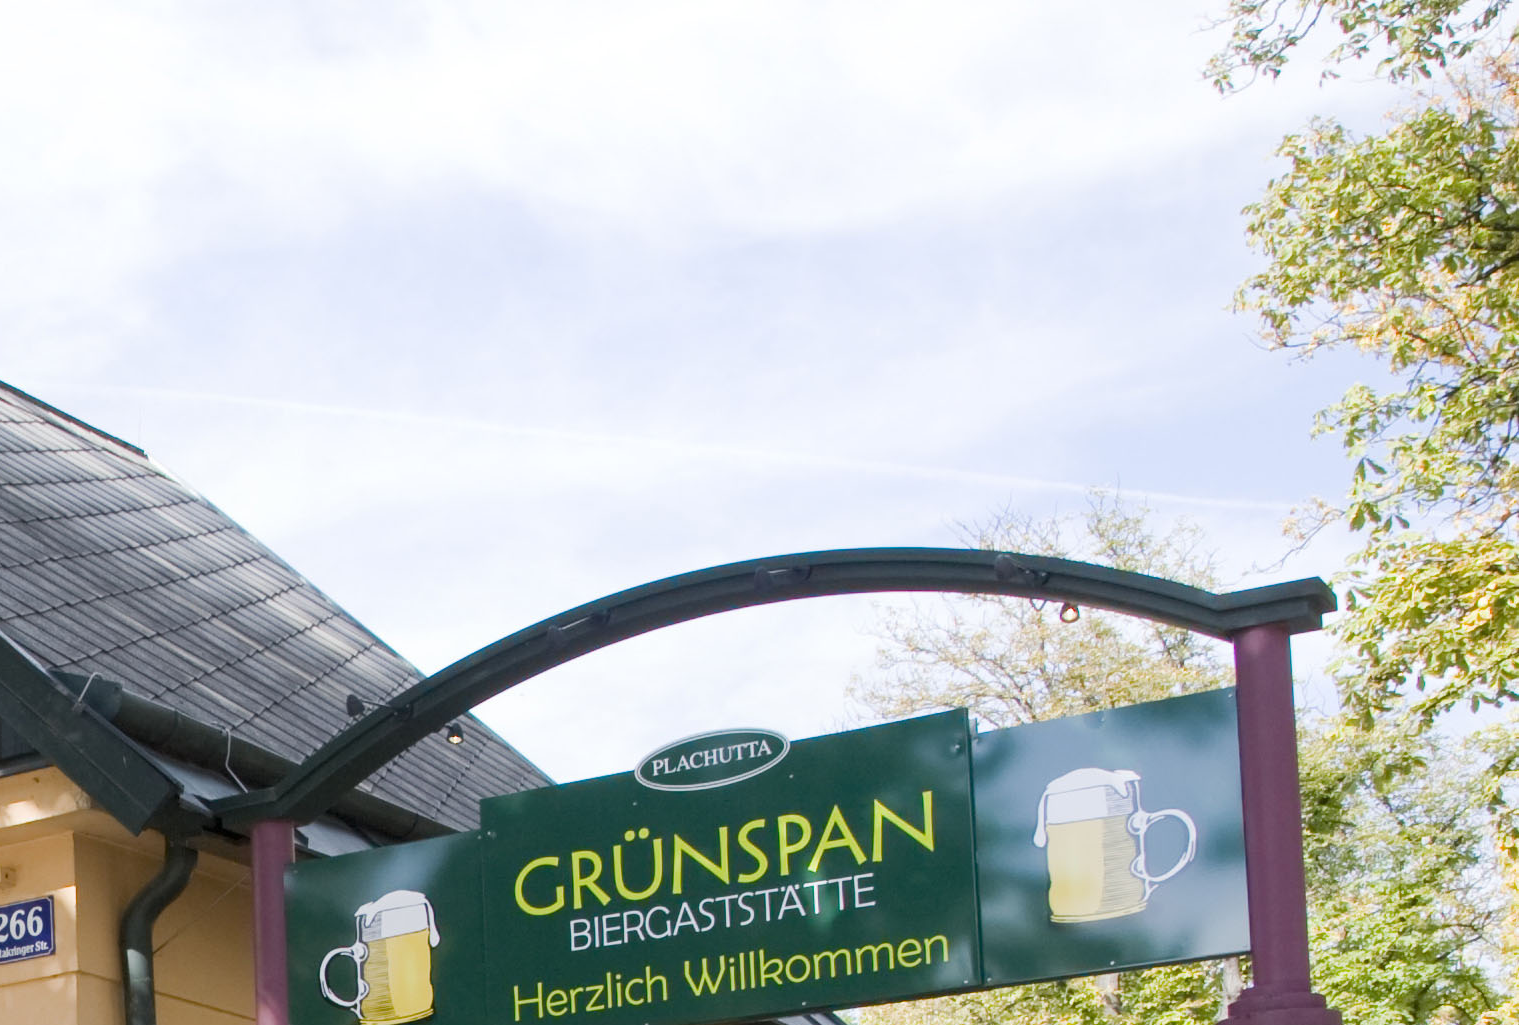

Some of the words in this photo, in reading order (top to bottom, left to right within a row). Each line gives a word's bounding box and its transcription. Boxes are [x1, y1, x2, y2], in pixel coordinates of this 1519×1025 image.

[651, 739, 773, 777] PLACHUTTA
[514, 790, 934, 916] GRÜNSPAN
[569, 872, 877, 952] BIERGASTSTÄTTE
[513, 965, 669, 1022] Herzlich
[683, 933, 950, 997] Willkommen
